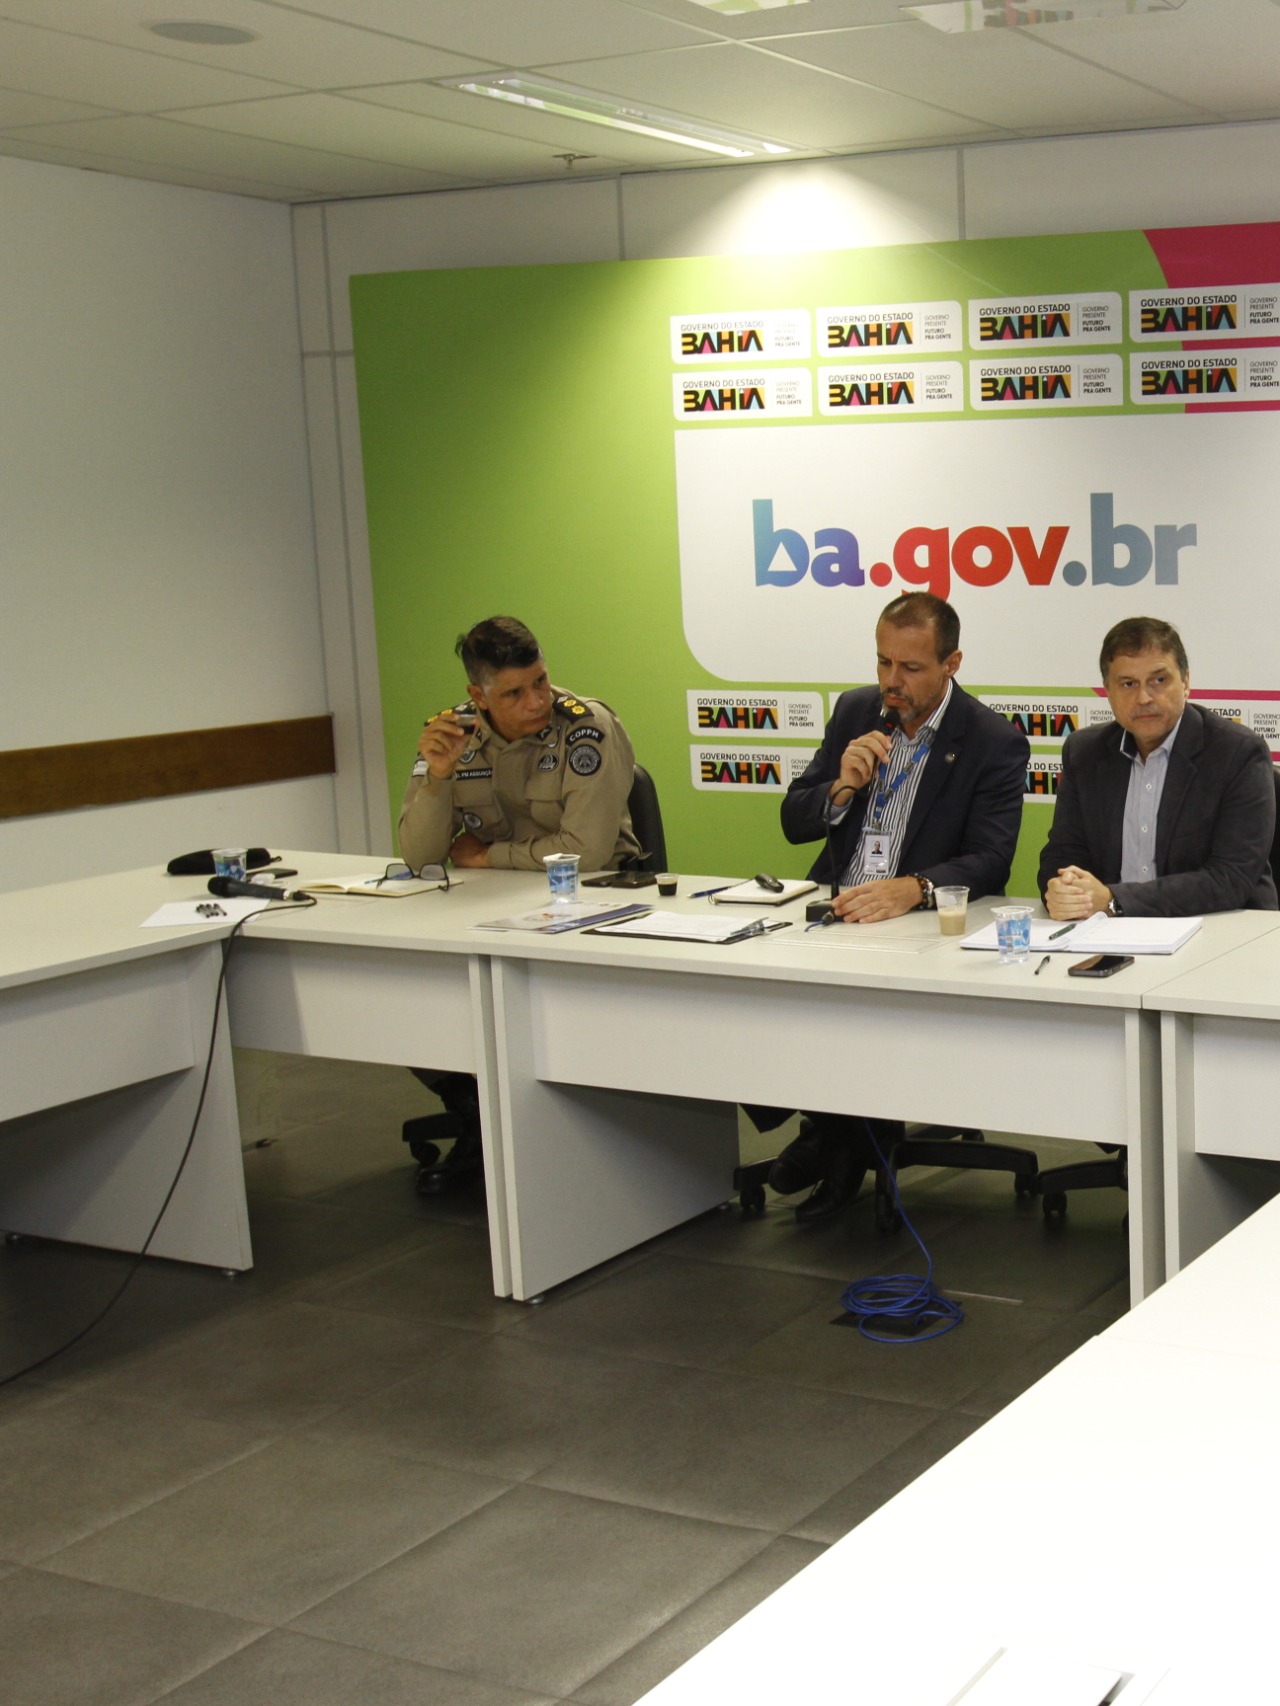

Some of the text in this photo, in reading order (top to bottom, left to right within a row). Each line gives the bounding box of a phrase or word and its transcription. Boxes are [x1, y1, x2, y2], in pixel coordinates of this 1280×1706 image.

[1140, 294, 1237, 307] GOVERNO DO ESTADO
[979, 303, 1070, 316] GOVERNO DO ESTADO
[827, 312, 913, 324] GOVERNO DO ESTADO
[1141, 357, 1237, 370] GOVERNO DO ESTADO
[980, 364, 1071, 376] GOVERNO DO ESTADO
[828, 371, 914, 383] GOVERNO DO ESTADO
[752, 492, 1197, 601] ba.gov.br
[990, 704, 1078, 713] GOVERNO DO ESTADO
[570, 729, 599, 741] COPPM
[700, 752, 737, 760] GOVERNO
